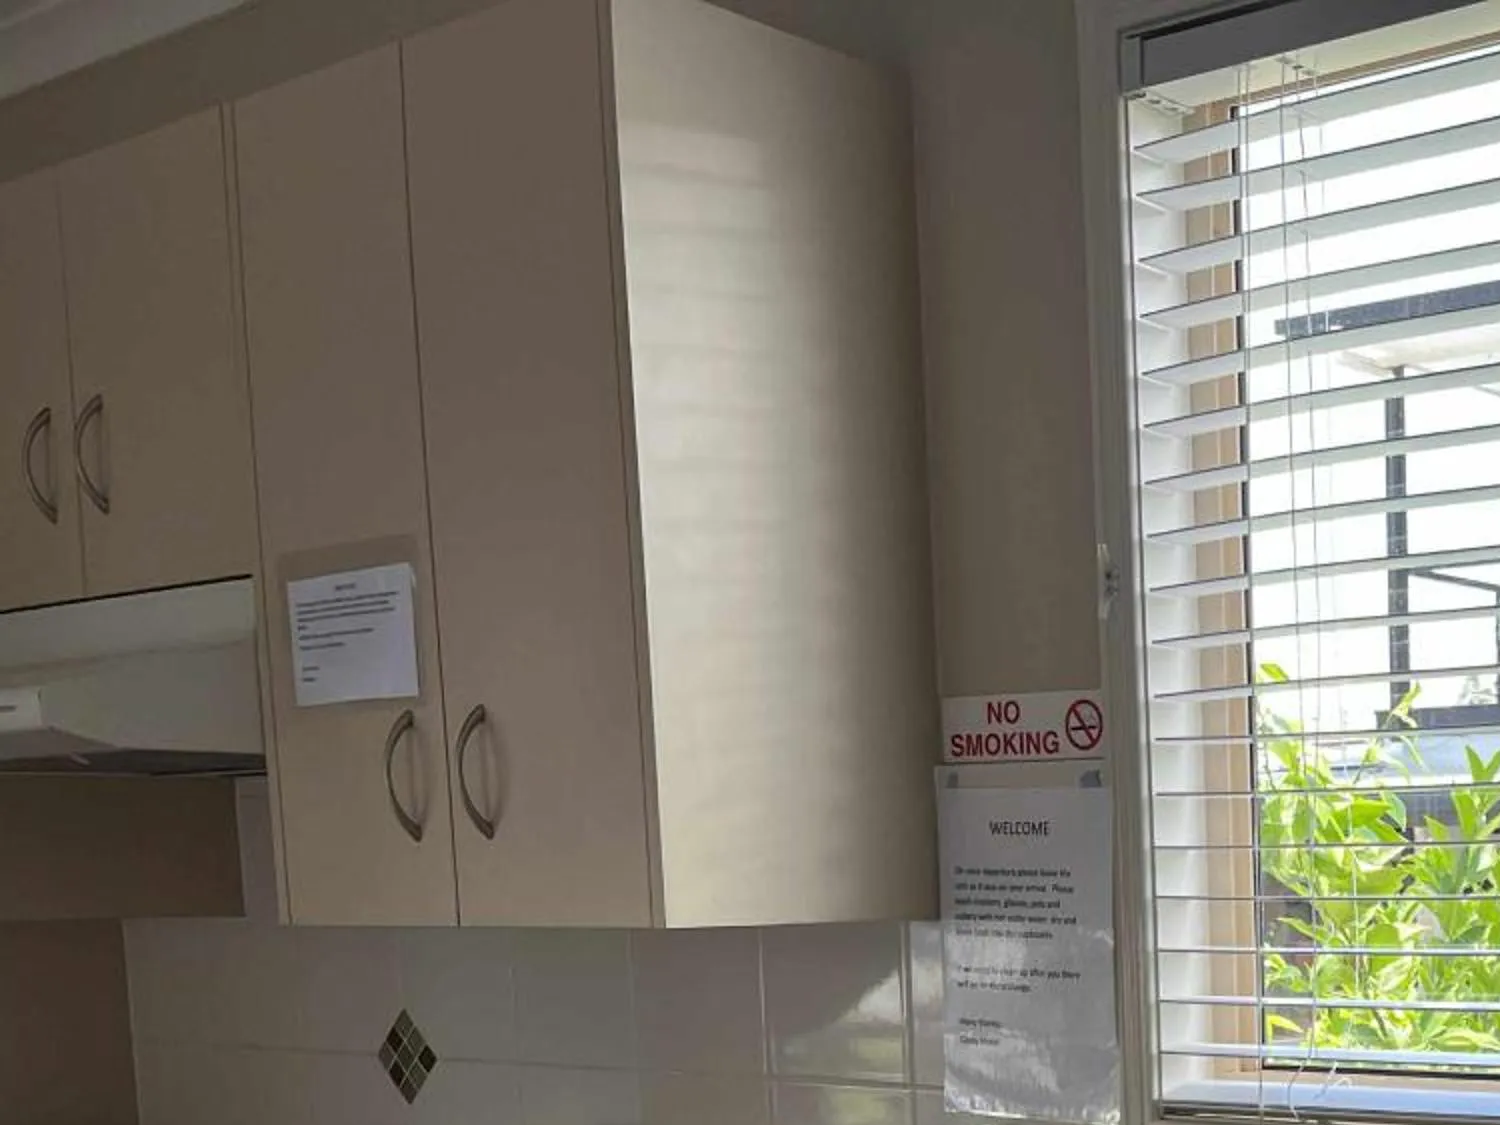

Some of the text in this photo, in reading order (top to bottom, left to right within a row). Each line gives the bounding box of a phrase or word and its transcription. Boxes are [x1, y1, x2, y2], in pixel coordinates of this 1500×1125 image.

[987, 701, 1021, 725] NO
[951, 730, 1060, 757] SMOKING
[989, 820, 1050, 836] WELCOME
